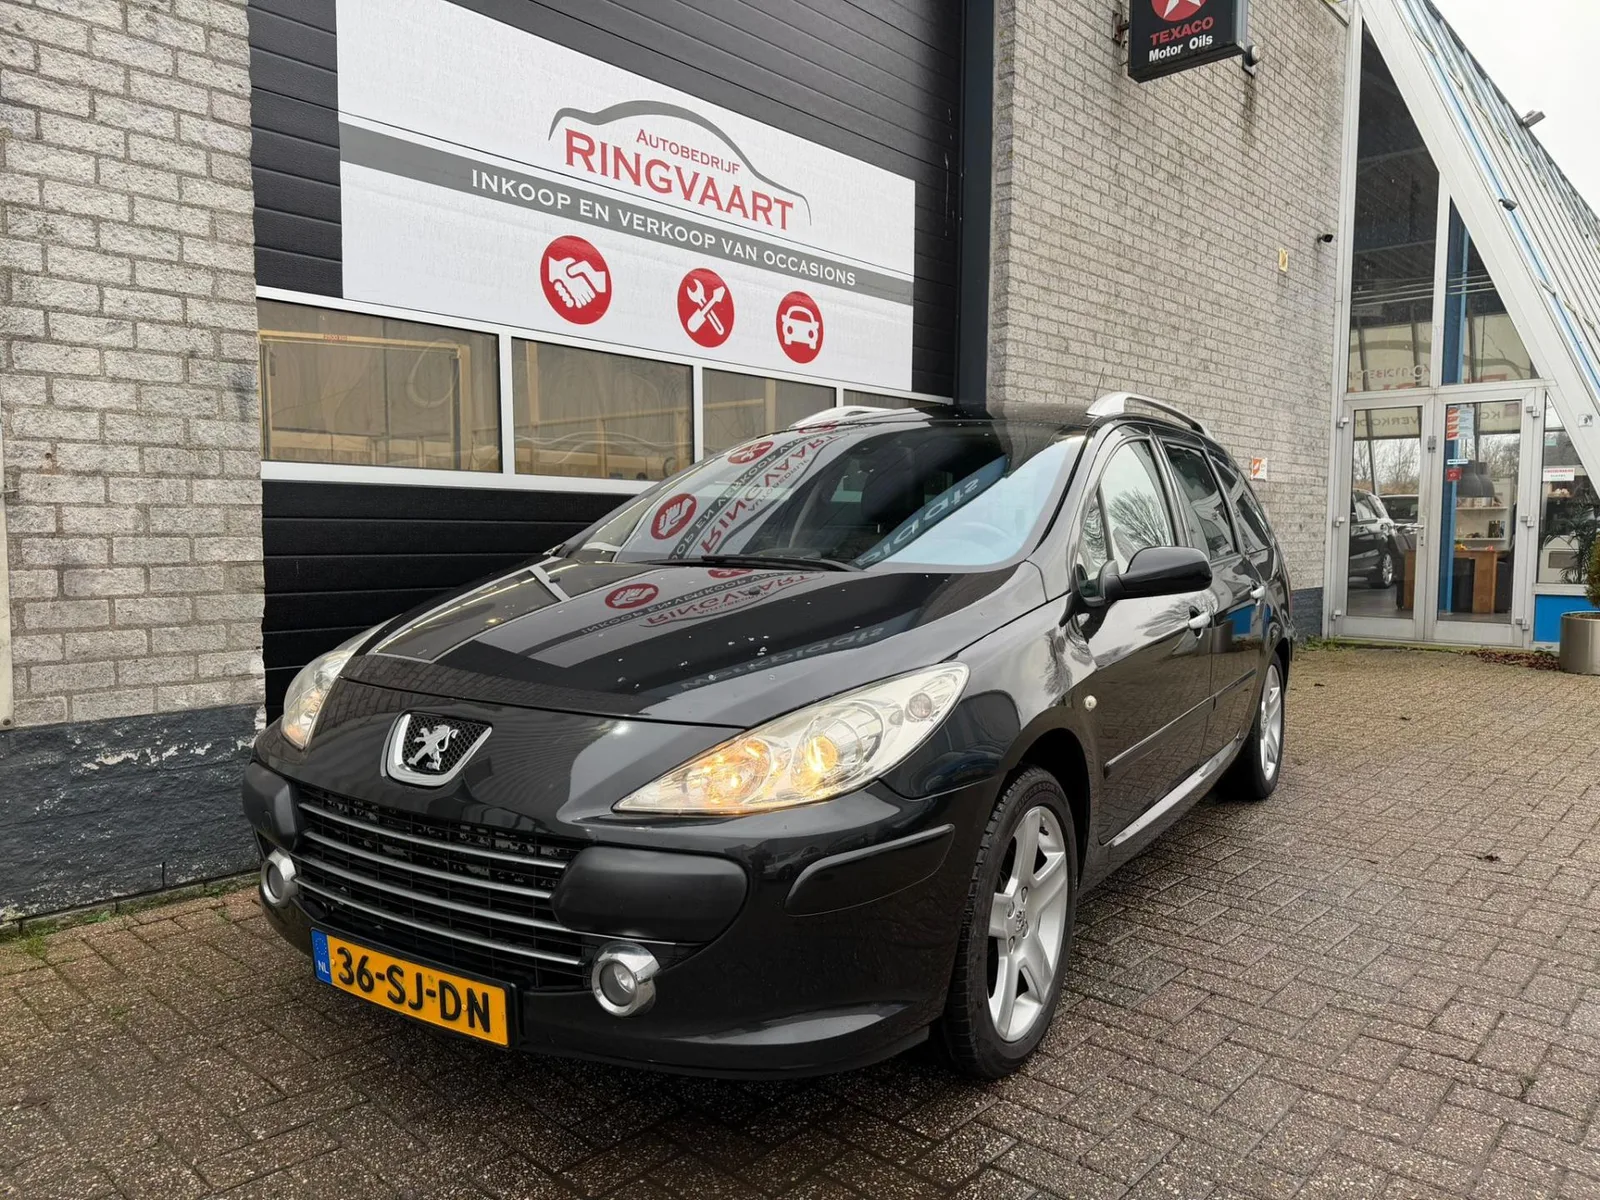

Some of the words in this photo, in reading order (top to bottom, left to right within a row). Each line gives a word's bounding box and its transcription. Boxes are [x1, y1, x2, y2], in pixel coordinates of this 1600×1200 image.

[1149, 43, 1183, 62] Motor
[1189, 34, 1213, 50] Oils
[1150, 17, 1214, 46] TEXACO
[636, 129, 740, 175] AUTOBEDRIJF
[564, 128, 793, 231] RINGVAART
[472, 169, 571, 210] INKOOP
[579, 199, 610, 222] EN
[618, 209, 716, 249] VERKOOP
[721, 238, 757, 261] VAN
[763, 250, 856, 286] OCCASIONS
[318, 960, 329, 974] NL
[337, 946, 491, 1033] 36-SJ-DN
